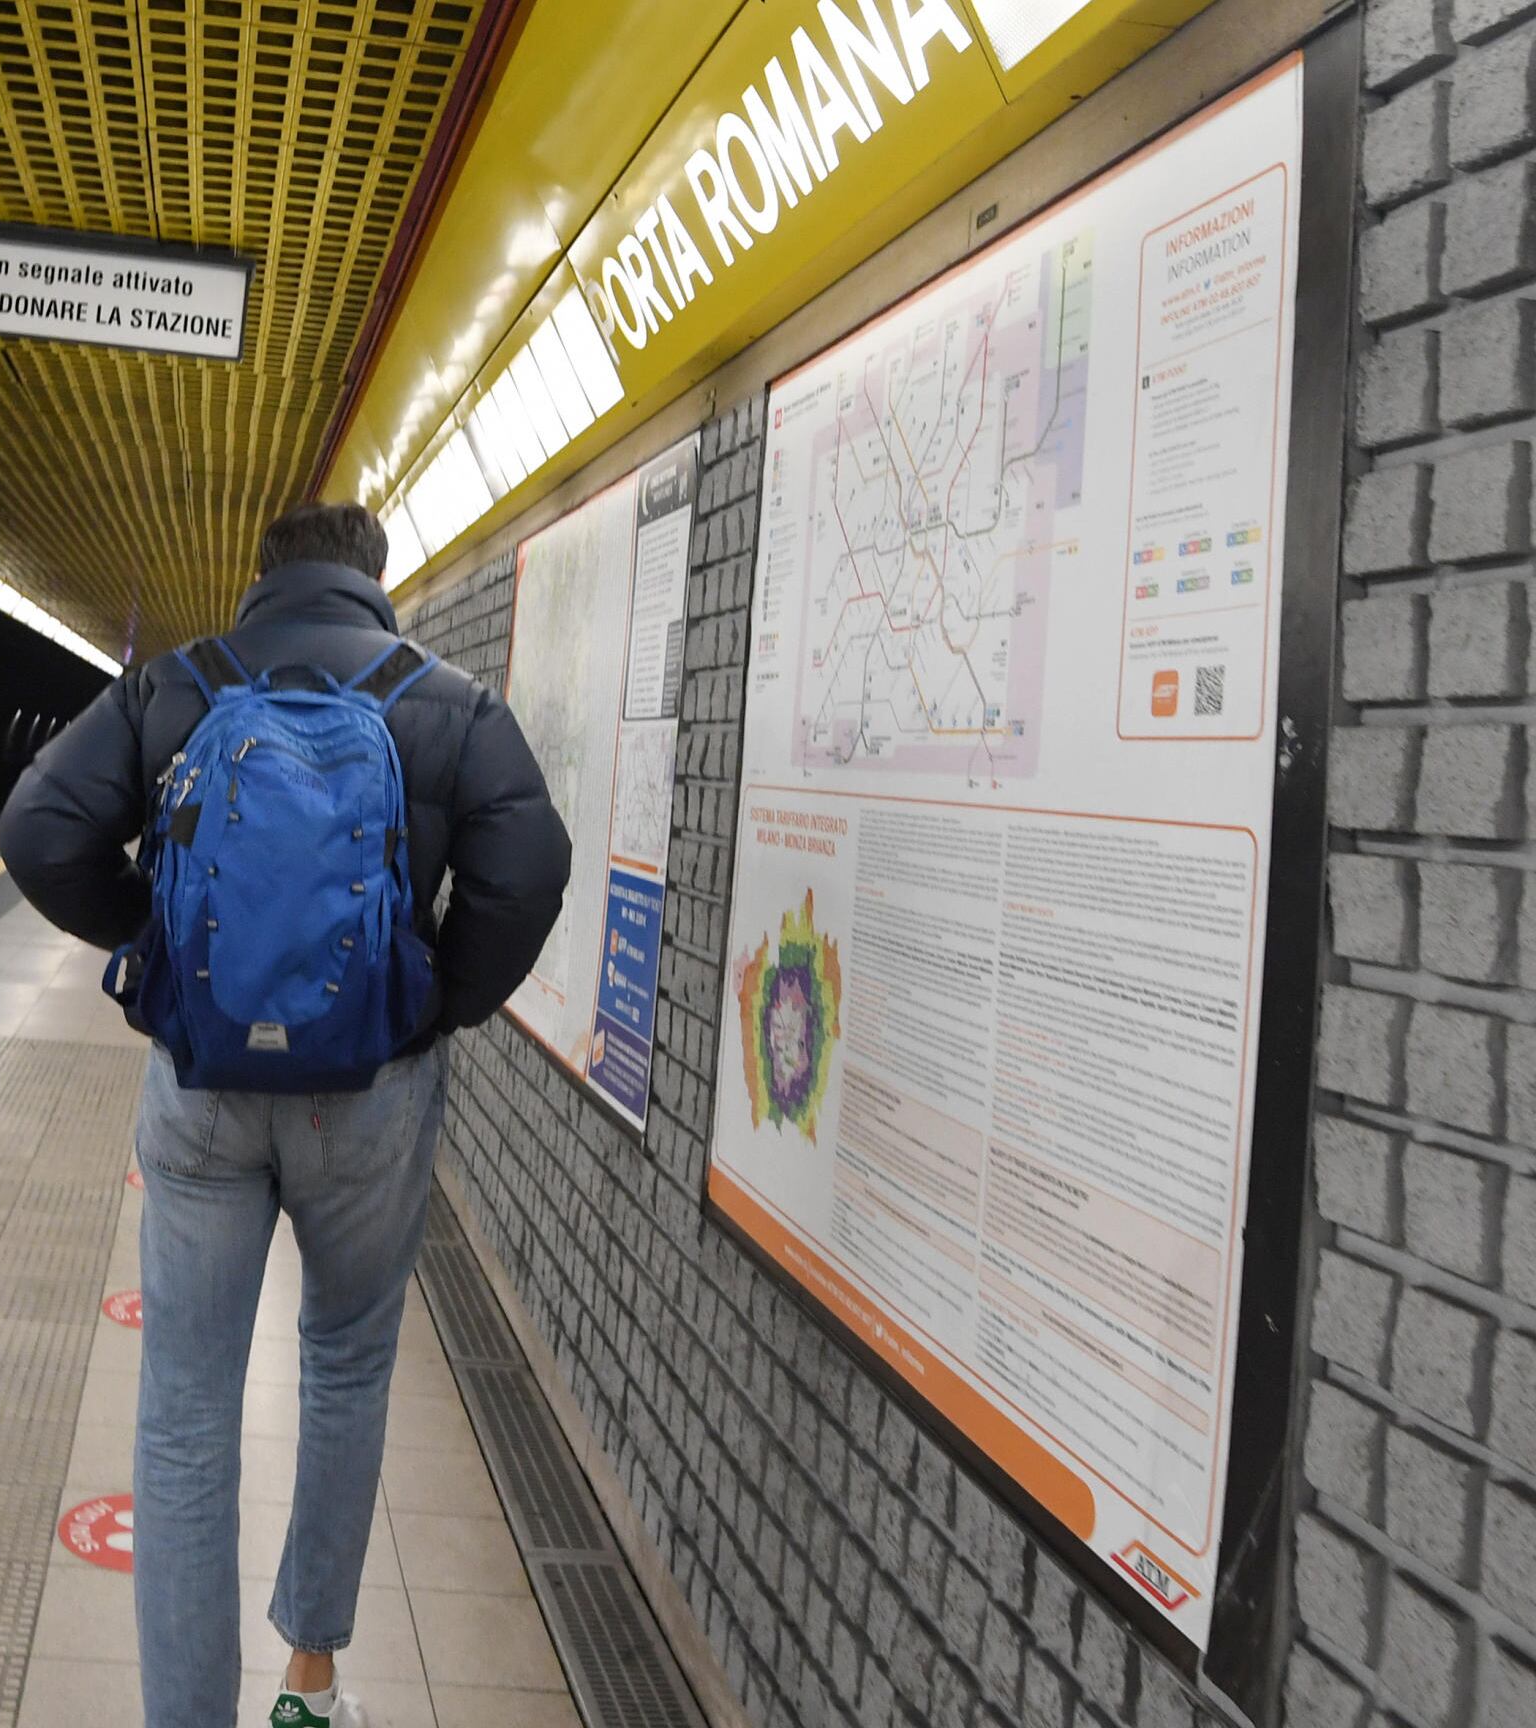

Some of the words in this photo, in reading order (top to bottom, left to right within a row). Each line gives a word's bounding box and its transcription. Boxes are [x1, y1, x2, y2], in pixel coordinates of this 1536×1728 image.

[583, 192, 714, 366] PORTA
[683, 0, 973, 268] ROMANA
[1166, 198, 1254, 258] INFORMAZIONI
[1168, 227, 1251, 283] INFORMATION
[18, 261, 104, 285] segnale
[112, 270, 193, 297] attivato
[96, 304, 121, 327] LA
[130, 308, 233, 340] STAZIONE
[750, 806, 775, 824] SISTEMA
[810, 813, 848, 836] INTEGRATO
[1134, 1553, 1170, 1598] ATM
